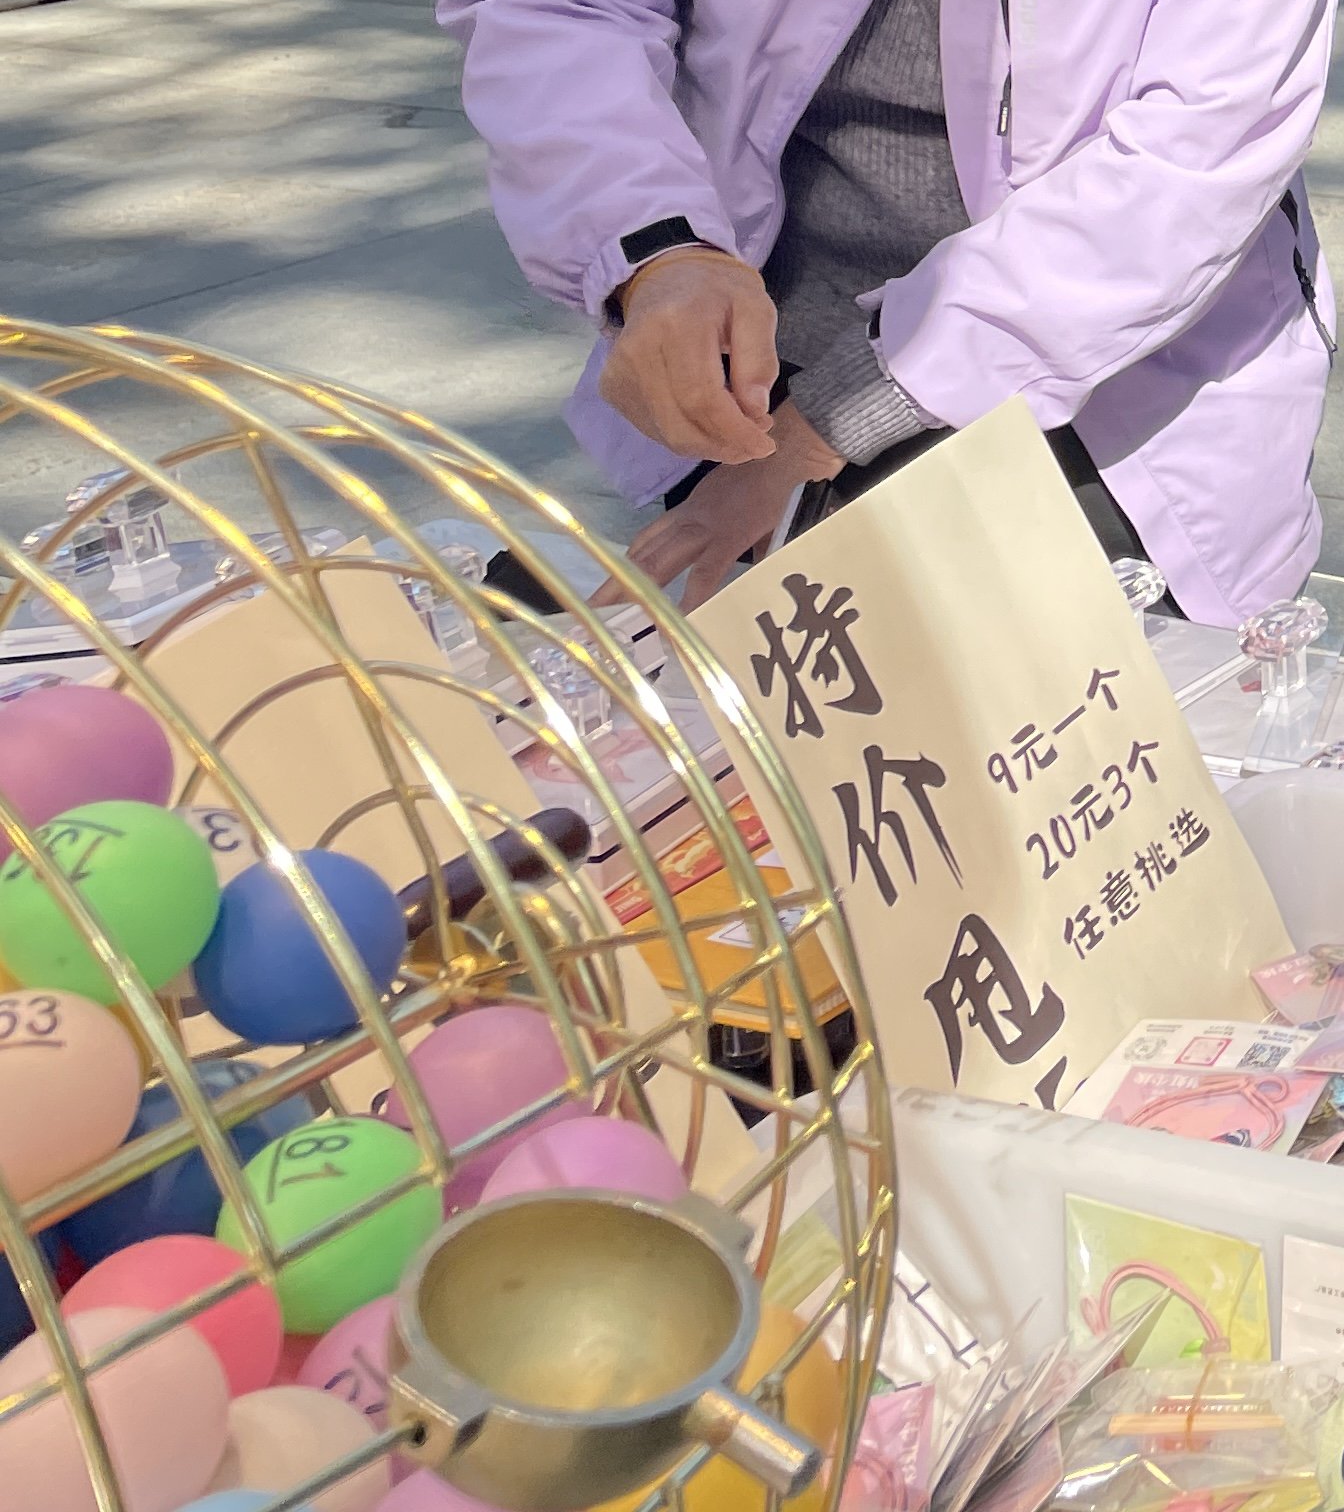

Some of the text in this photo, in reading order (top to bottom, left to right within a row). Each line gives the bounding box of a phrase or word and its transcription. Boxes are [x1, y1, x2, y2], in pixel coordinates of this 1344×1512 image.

[987, 667, 1121, 794] 9元一个
[750, 572, 1068, 1112] 特价甩
[1026, 739, 1160, 881] 20元3个
[1063, 806, 1211, 961] 任意挑选
